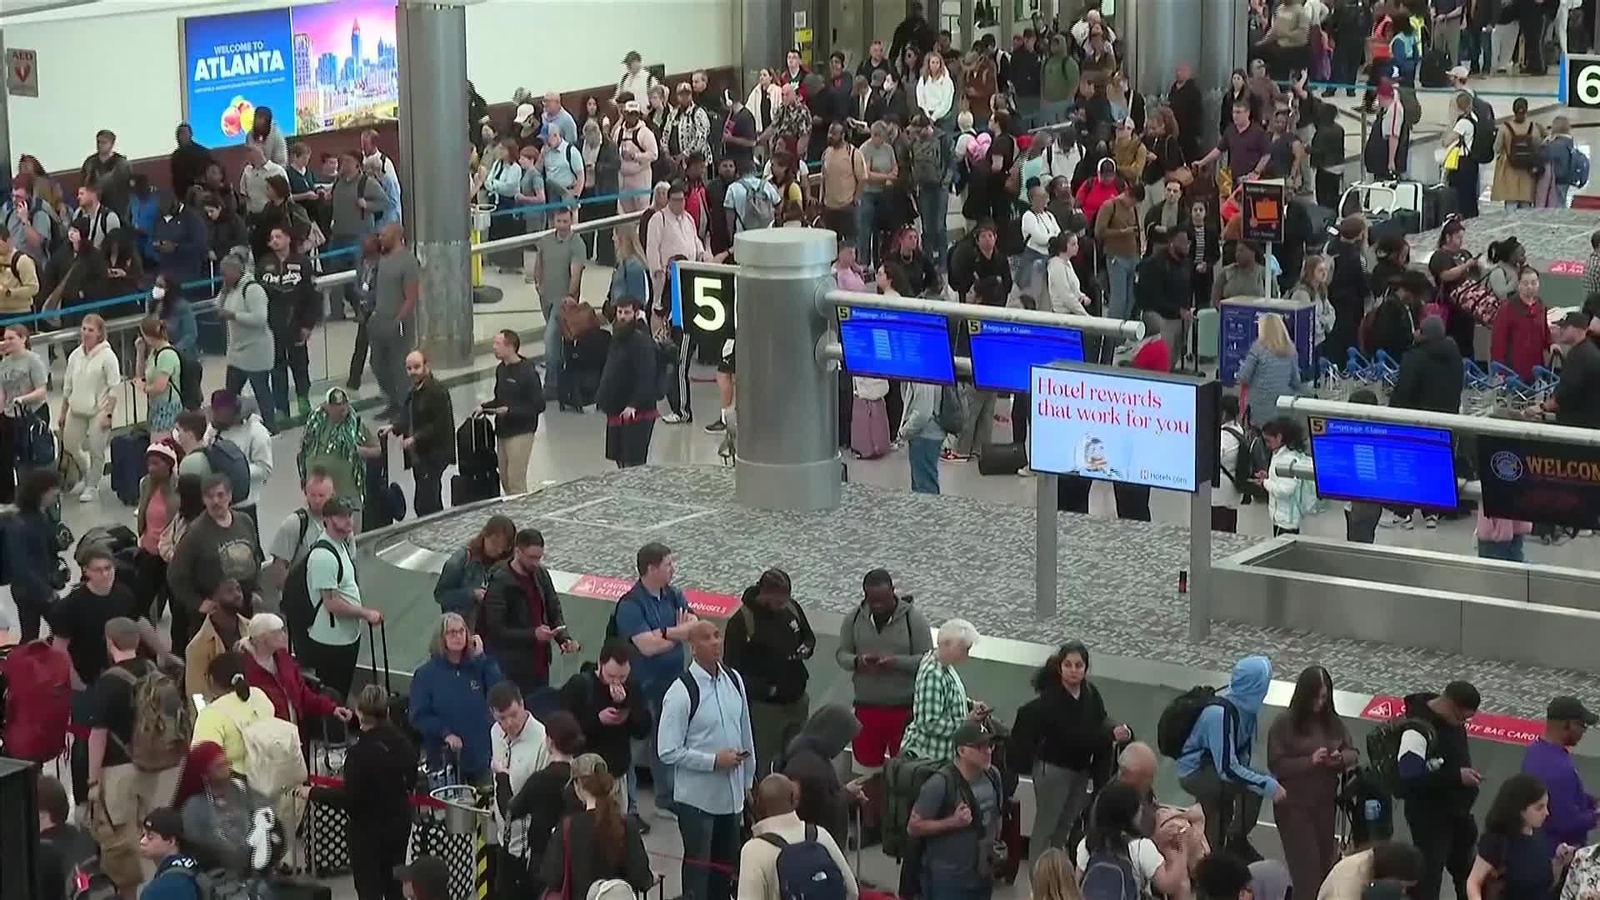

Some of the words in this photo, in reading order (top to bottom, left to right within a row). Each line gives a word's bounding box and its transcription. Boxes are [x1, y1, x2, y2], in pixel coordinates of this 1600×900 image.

[214, 42, 251, 55] WELCOME
[253, 41, 264, 50] TO
[194, 49, 285, 81] ATLANTA
[1577, 64, 1600, 105] 6
[693, 276, 726, 331] 5
[840, 308, 848, 319] 5
[970, 321, 979, 332] 5
[982, 323, 1011, 333] Baggage
[1038, 376, 1086, 400] Hotel
[1089, 388, 1162, 409] rewards
[1037, 398, 1073, 420] that
[1077, 405, 1121, 426] work
[1126, 409, 1152, 429] for
[1155, 416, 1190, 436] you
[1313, 419, 1323, 432] 5
[1483, 726, 1505, 736] BAG
